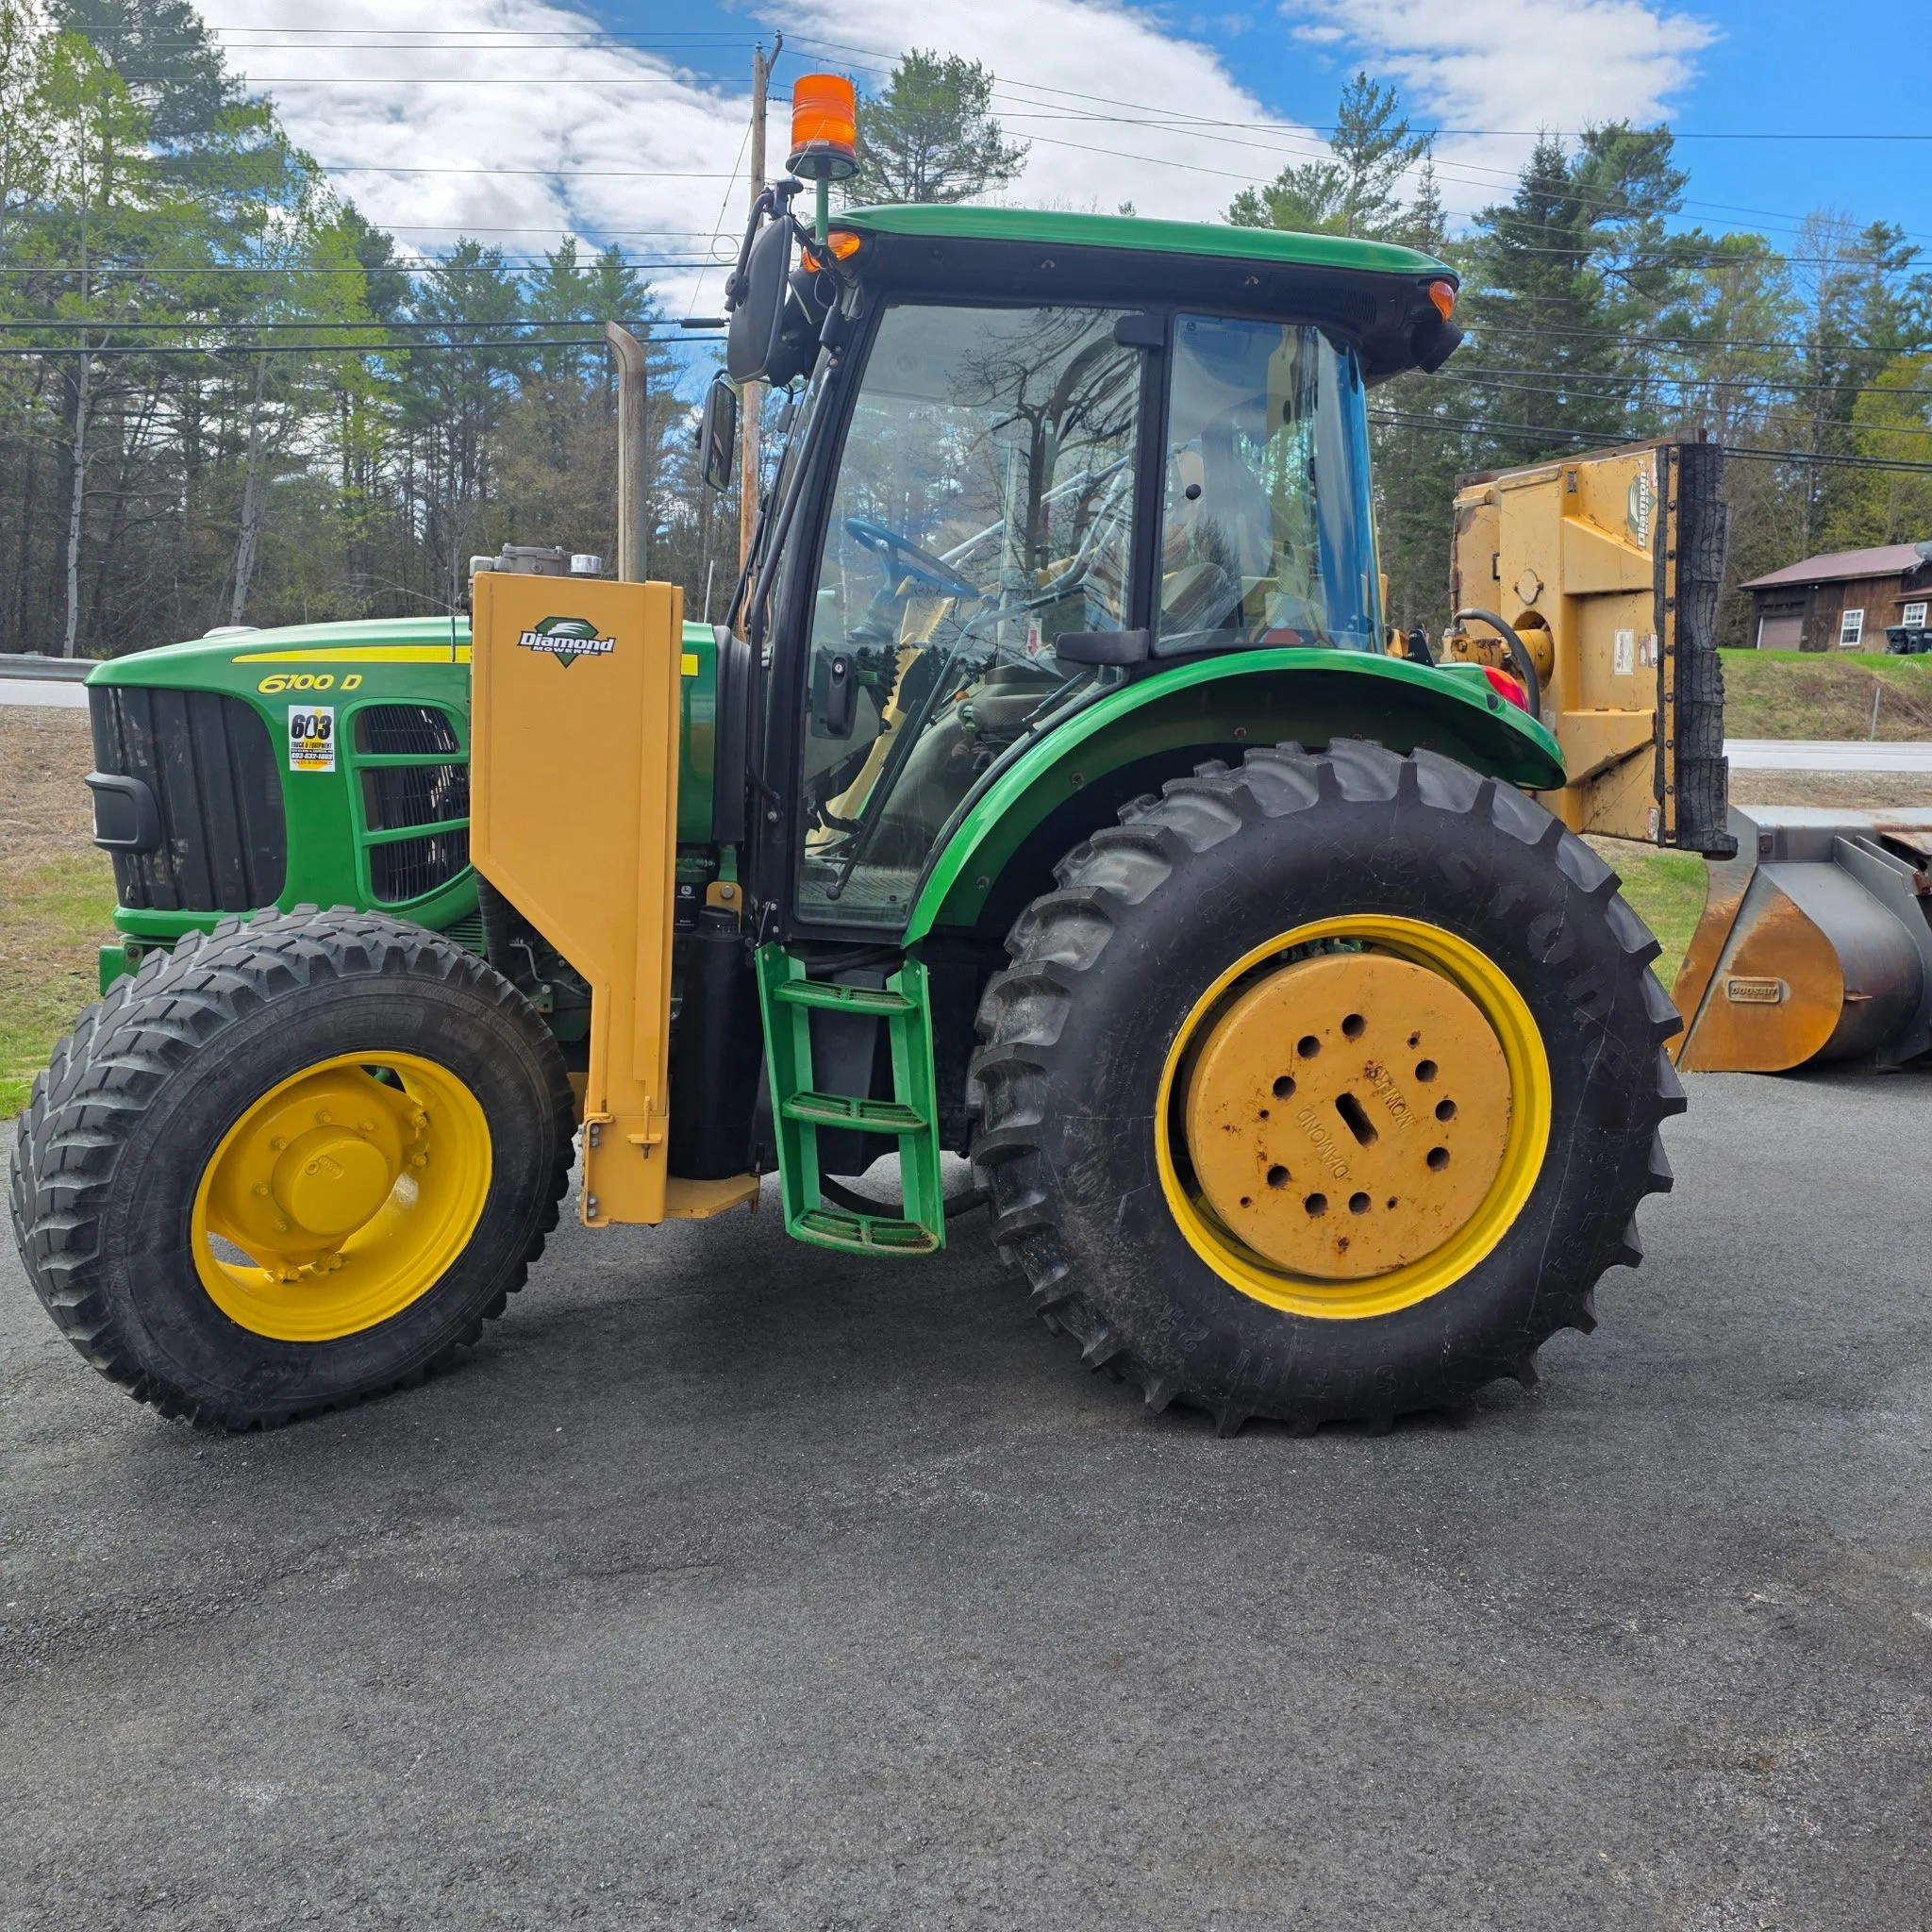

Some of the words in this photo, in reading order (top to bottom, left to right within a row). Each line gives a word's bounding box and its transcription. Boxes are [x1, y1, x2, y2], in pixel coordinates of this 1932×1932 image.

[519, 632, 615, 652] Diamond
[532, 646, 591, 655] MOWERS
[257, 674, 335, 694] 6100
[340, 674, 363, 691] D
[291, 714, 332, 740] 603
[1298, 1105, 1353, 1181] DIAMOND
